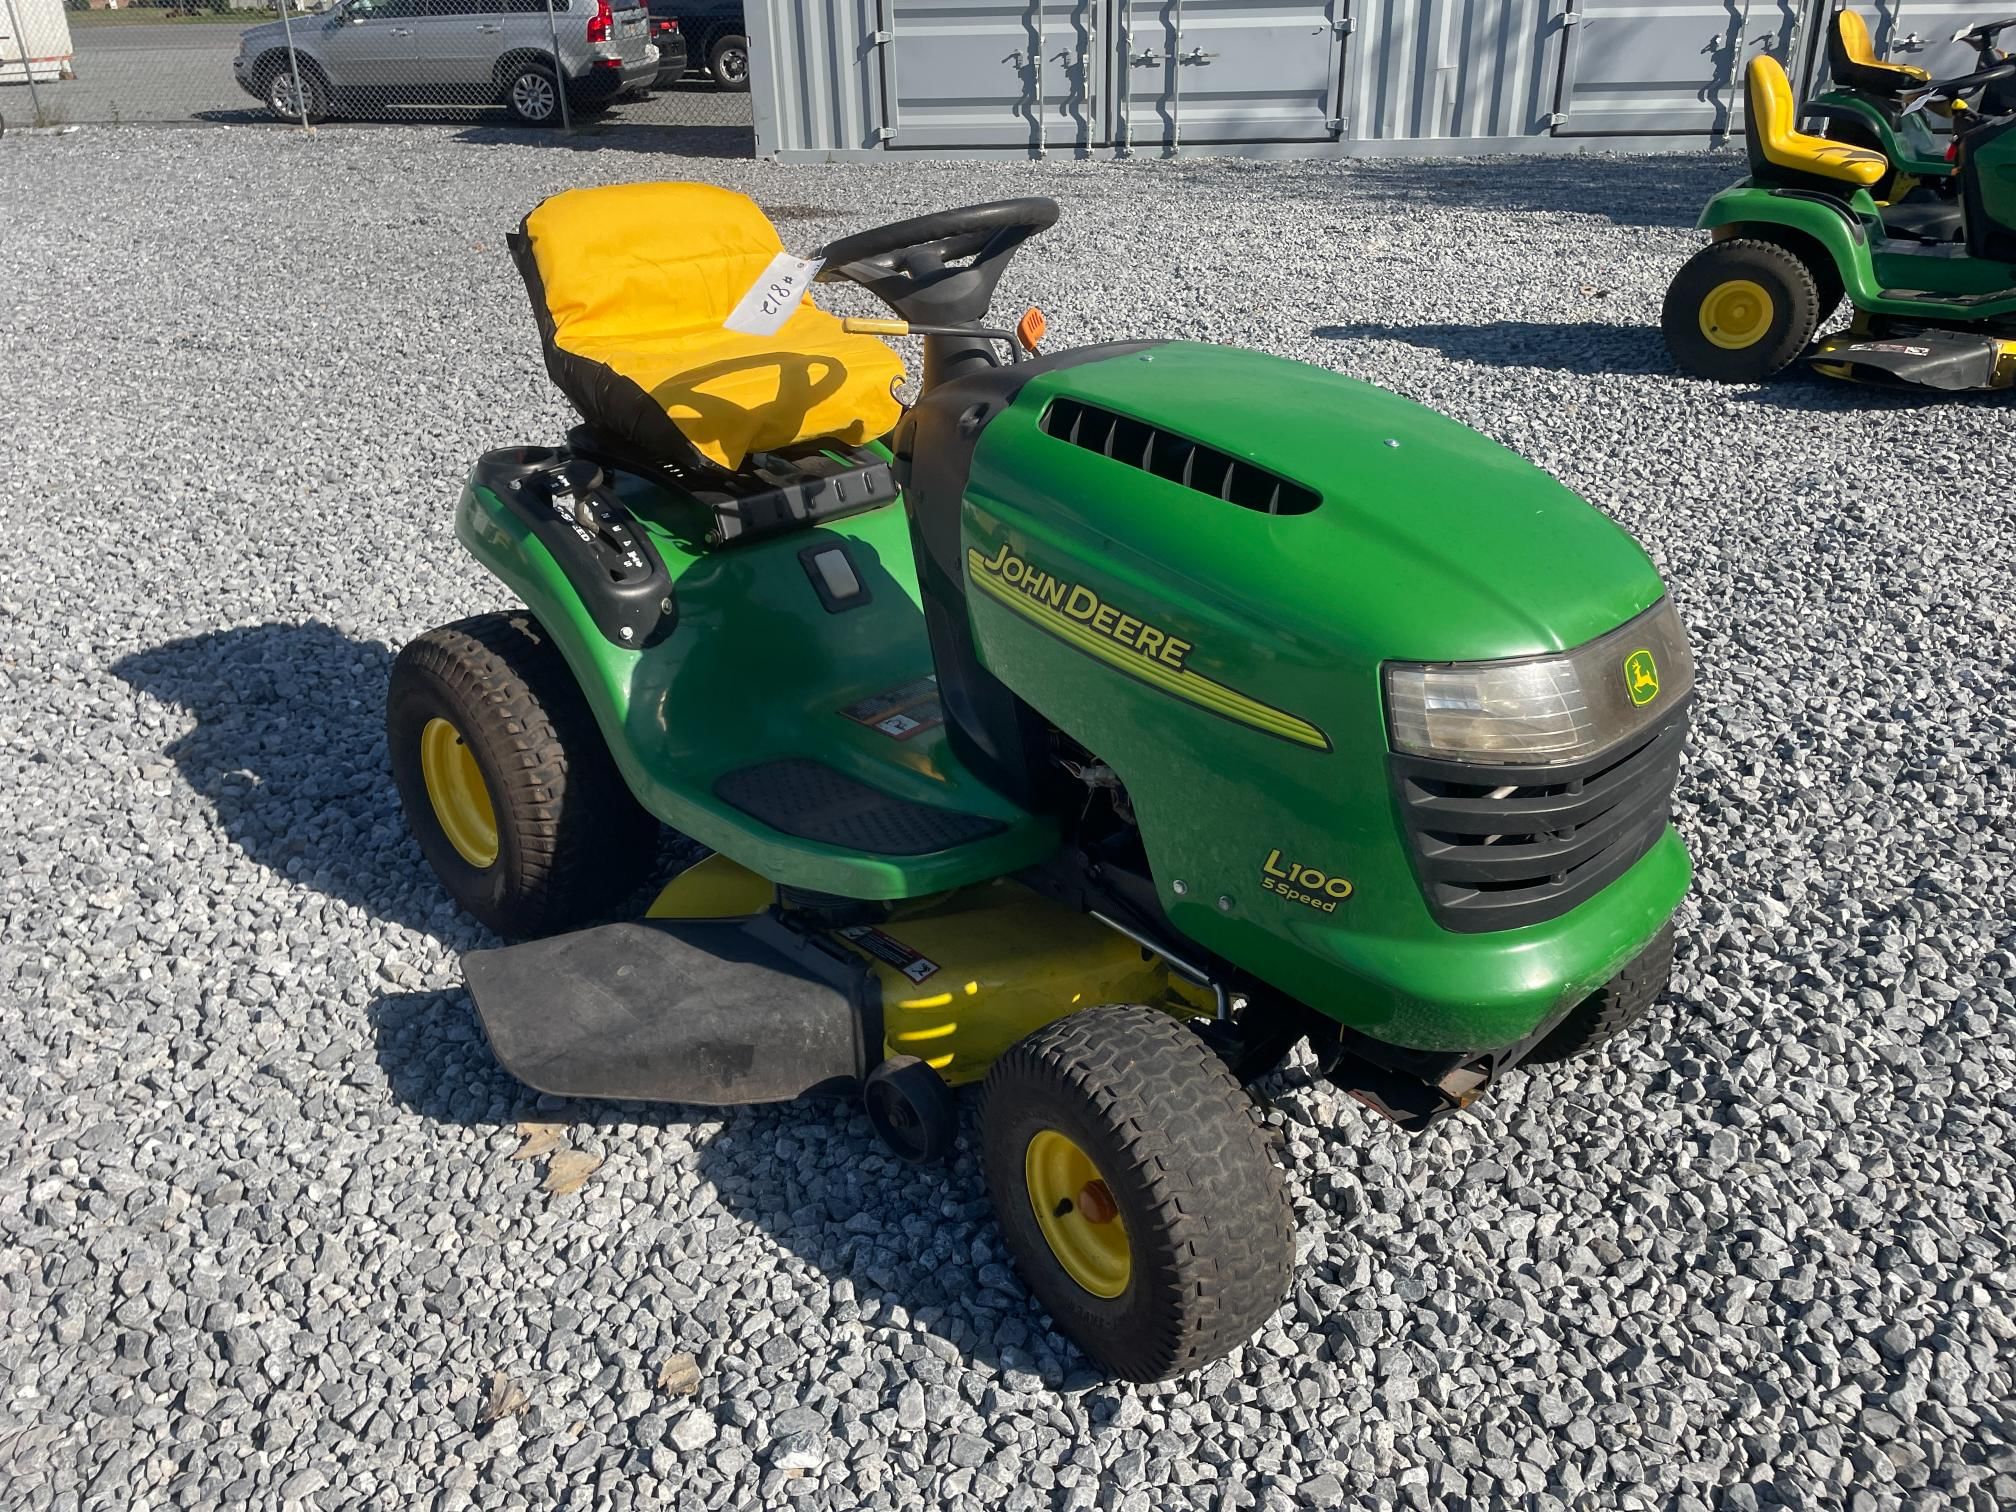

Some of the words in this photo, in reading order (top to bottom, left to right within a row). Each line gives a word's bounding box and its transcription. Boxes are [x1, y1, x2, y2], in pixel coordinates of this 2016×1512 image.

[983, 544, 1068, 609] JOHN
[1063, 584, 1192, 669] DEERE
[1262, 877, 1275, 889] 5
[1275, 882, 1337, 913] Speed
[1263, 849, 1353, 898] L100
